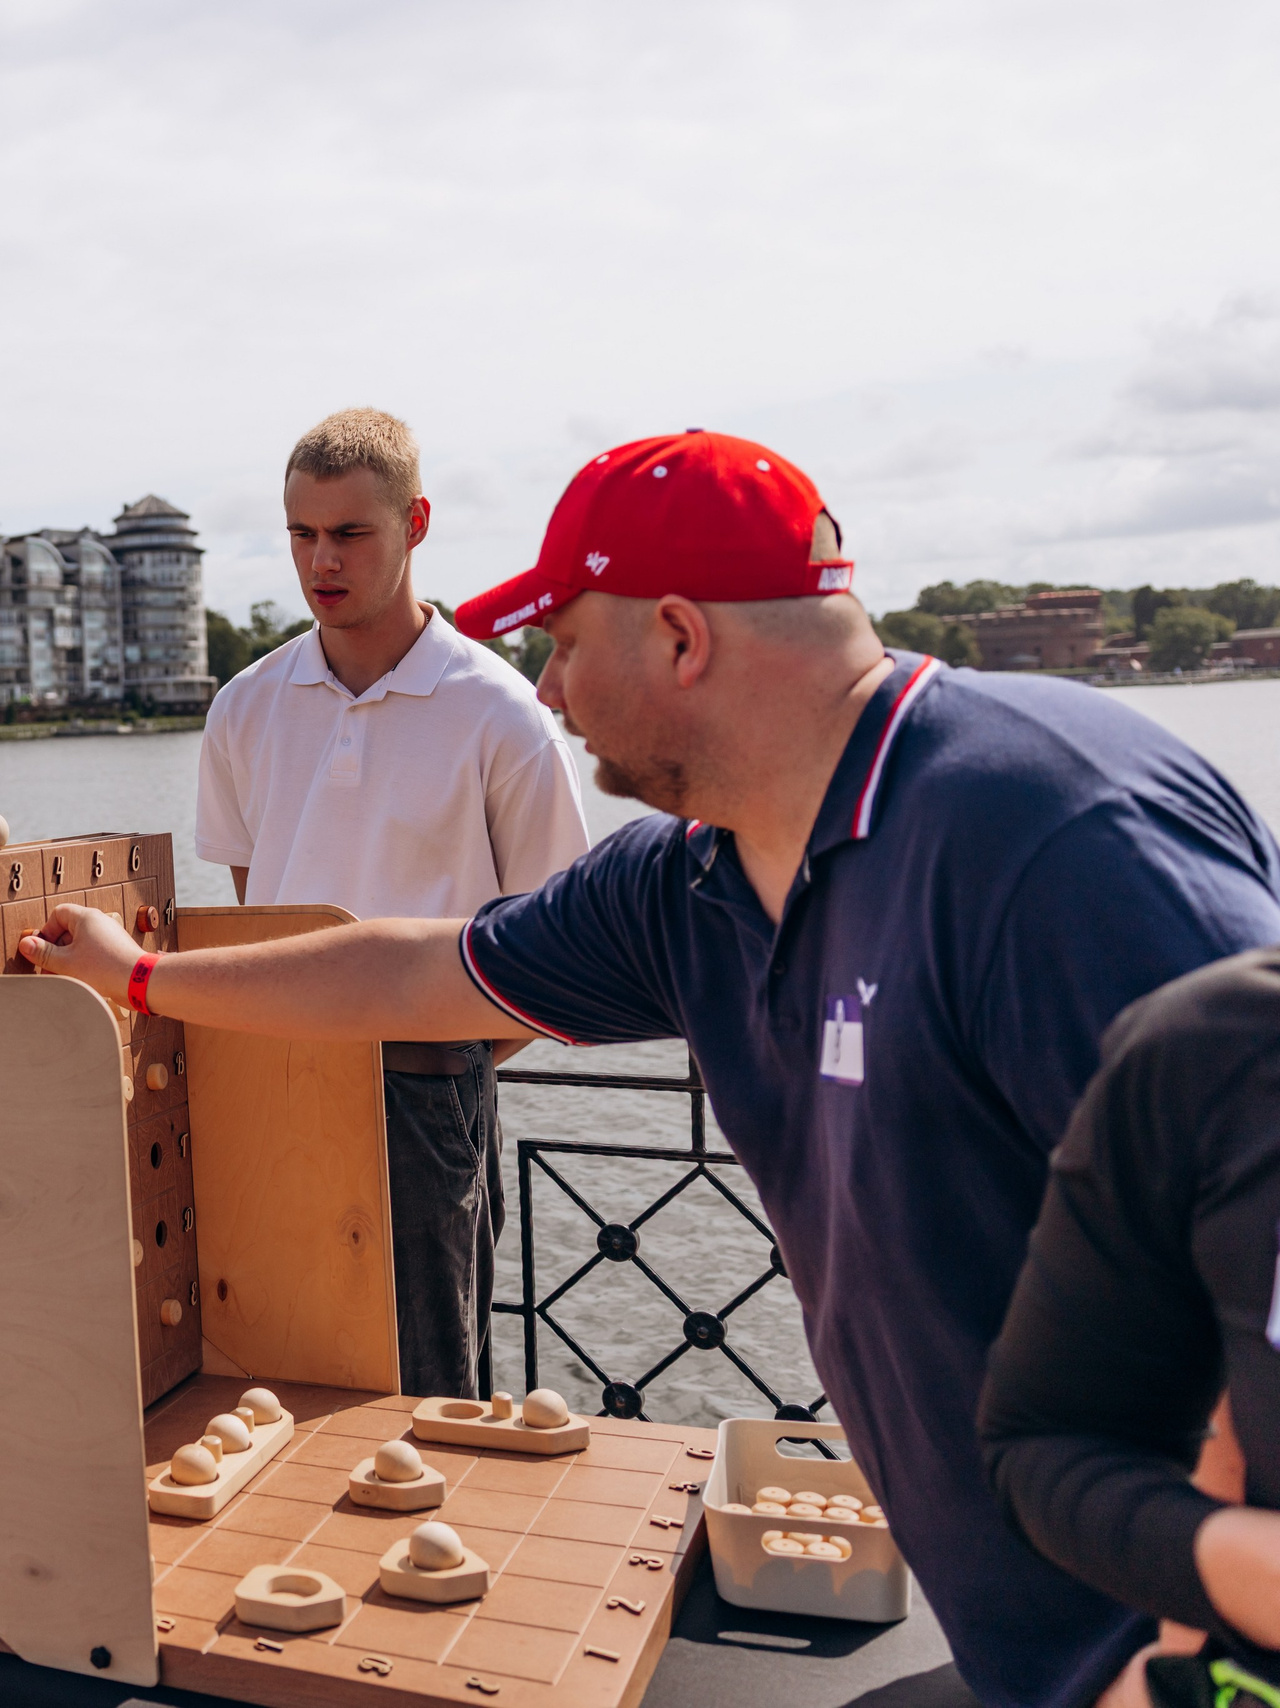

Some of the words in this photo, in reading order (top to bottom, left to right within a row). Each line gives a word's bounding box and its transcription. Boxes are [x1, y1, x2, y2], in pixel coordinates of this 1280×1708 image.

[492, 601, 538, 633] ARSENAL
[538, 592, 553, 610] FC
[11, 862, 24, 892] 3
[54, 856, 65, 885] 4
[94, 850, 105, 878] 5
[131, 845, 141, 872] 6
[649, 1514, 685, 1530] 4
[628, 1552, 665, 1571] 3
[605, 1595, 647, 1616] 2
[583, 1644, 622, 1664] 1
